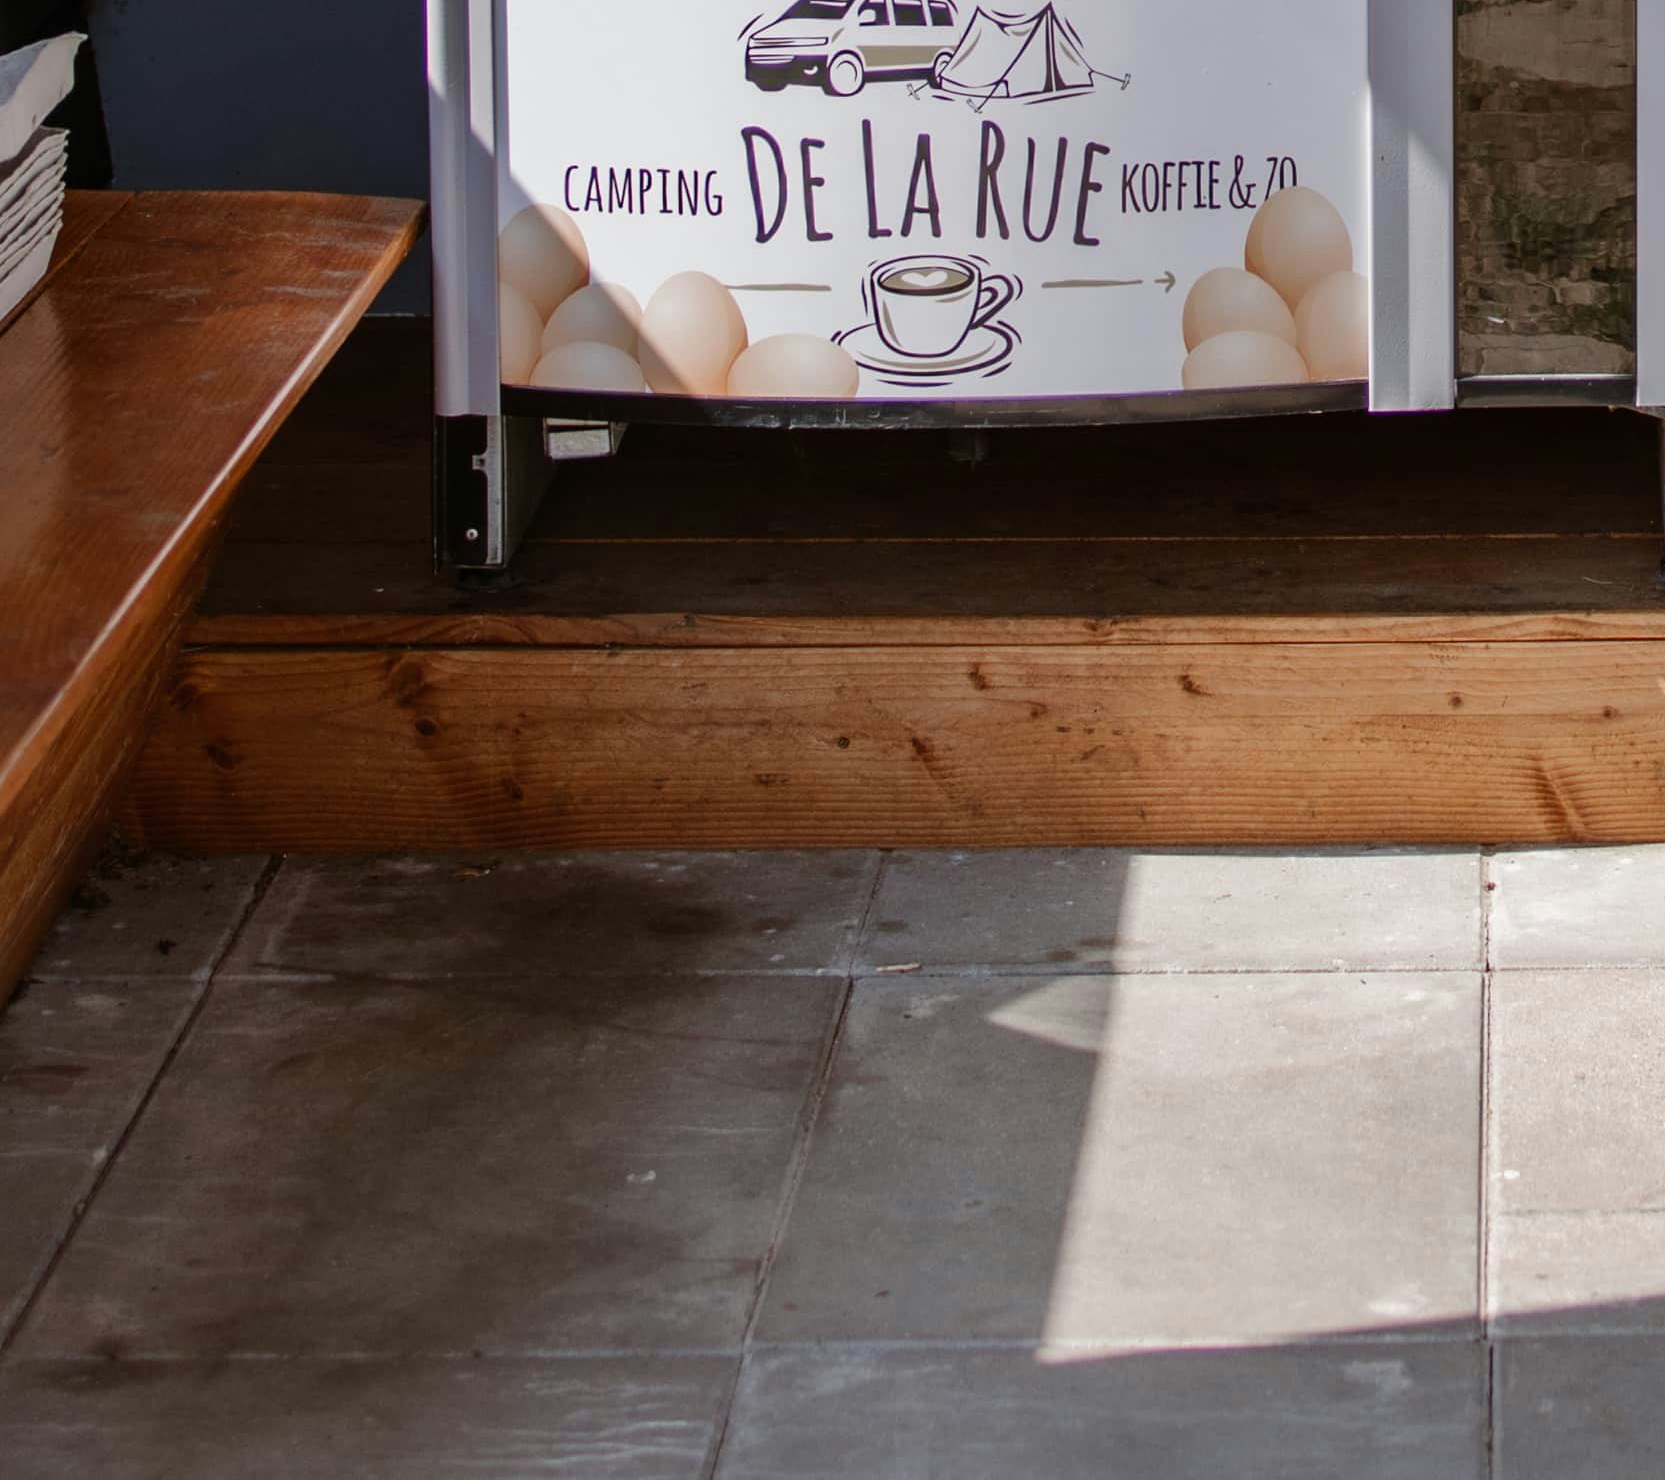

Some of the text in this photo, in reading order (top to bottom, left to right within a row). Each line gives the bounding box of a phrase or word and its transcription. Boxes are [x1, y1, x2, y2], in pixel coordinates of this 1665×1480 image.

[563, 164, 724, 217] CAMPING
[740, 125, 834, 244] DE
[861, 118, 942, 239] LA
[975, 119, 1111, 247] RUE
[1121, 160, 1221, 213] KOFFIE
[1228, 154, 1257, 209] &
